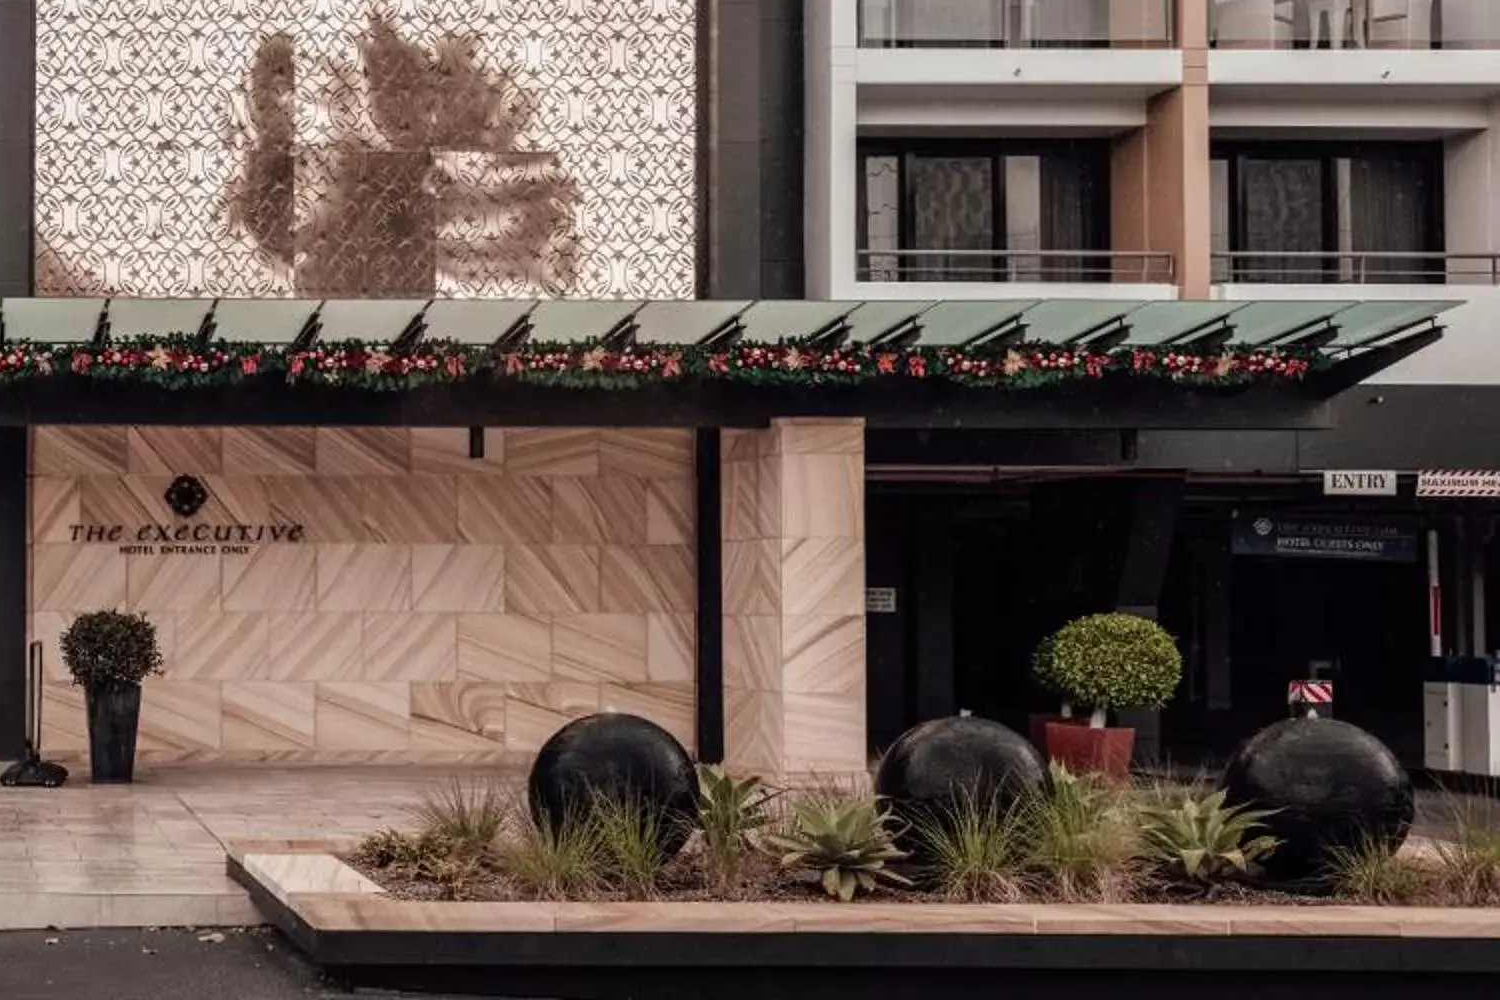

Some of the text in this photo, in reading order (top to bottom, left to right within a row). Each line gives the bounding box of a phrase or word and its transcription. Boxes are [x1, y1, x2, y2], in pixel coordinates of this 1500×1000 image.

[1331, 473, 1388, 489] ENTRY
[1421, 478, 1478, 487] MAXIMUM
[119, 545, 249, 555] HOTEL ENTRANCE ONLY
